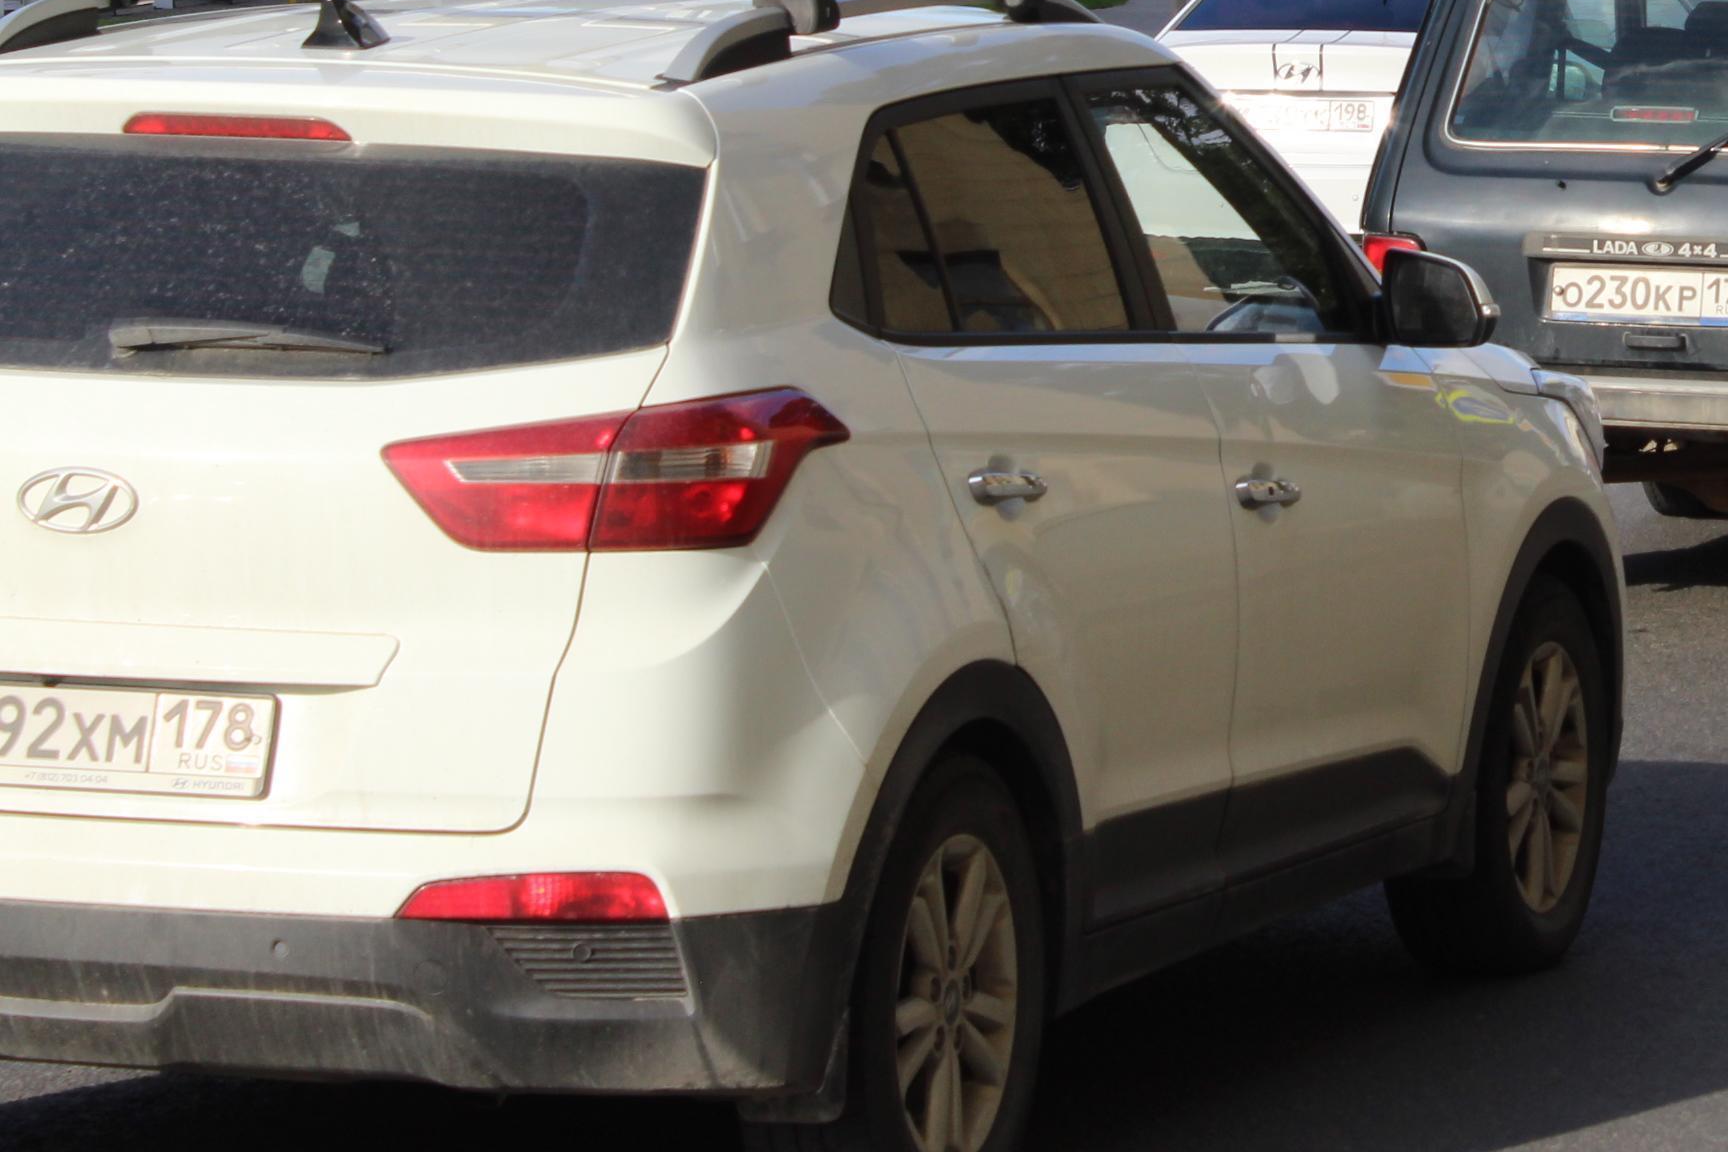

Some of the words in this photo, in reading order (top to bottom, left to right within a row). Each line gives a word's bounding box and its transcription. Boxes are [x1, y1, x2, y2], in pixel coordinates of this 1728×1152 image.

[1334, 103, 1367, 121] 198
[1593, 239, 1638, 256] LADA
[162, 698, 256, 752] 178
[177, 752, 223, 771] RUS
